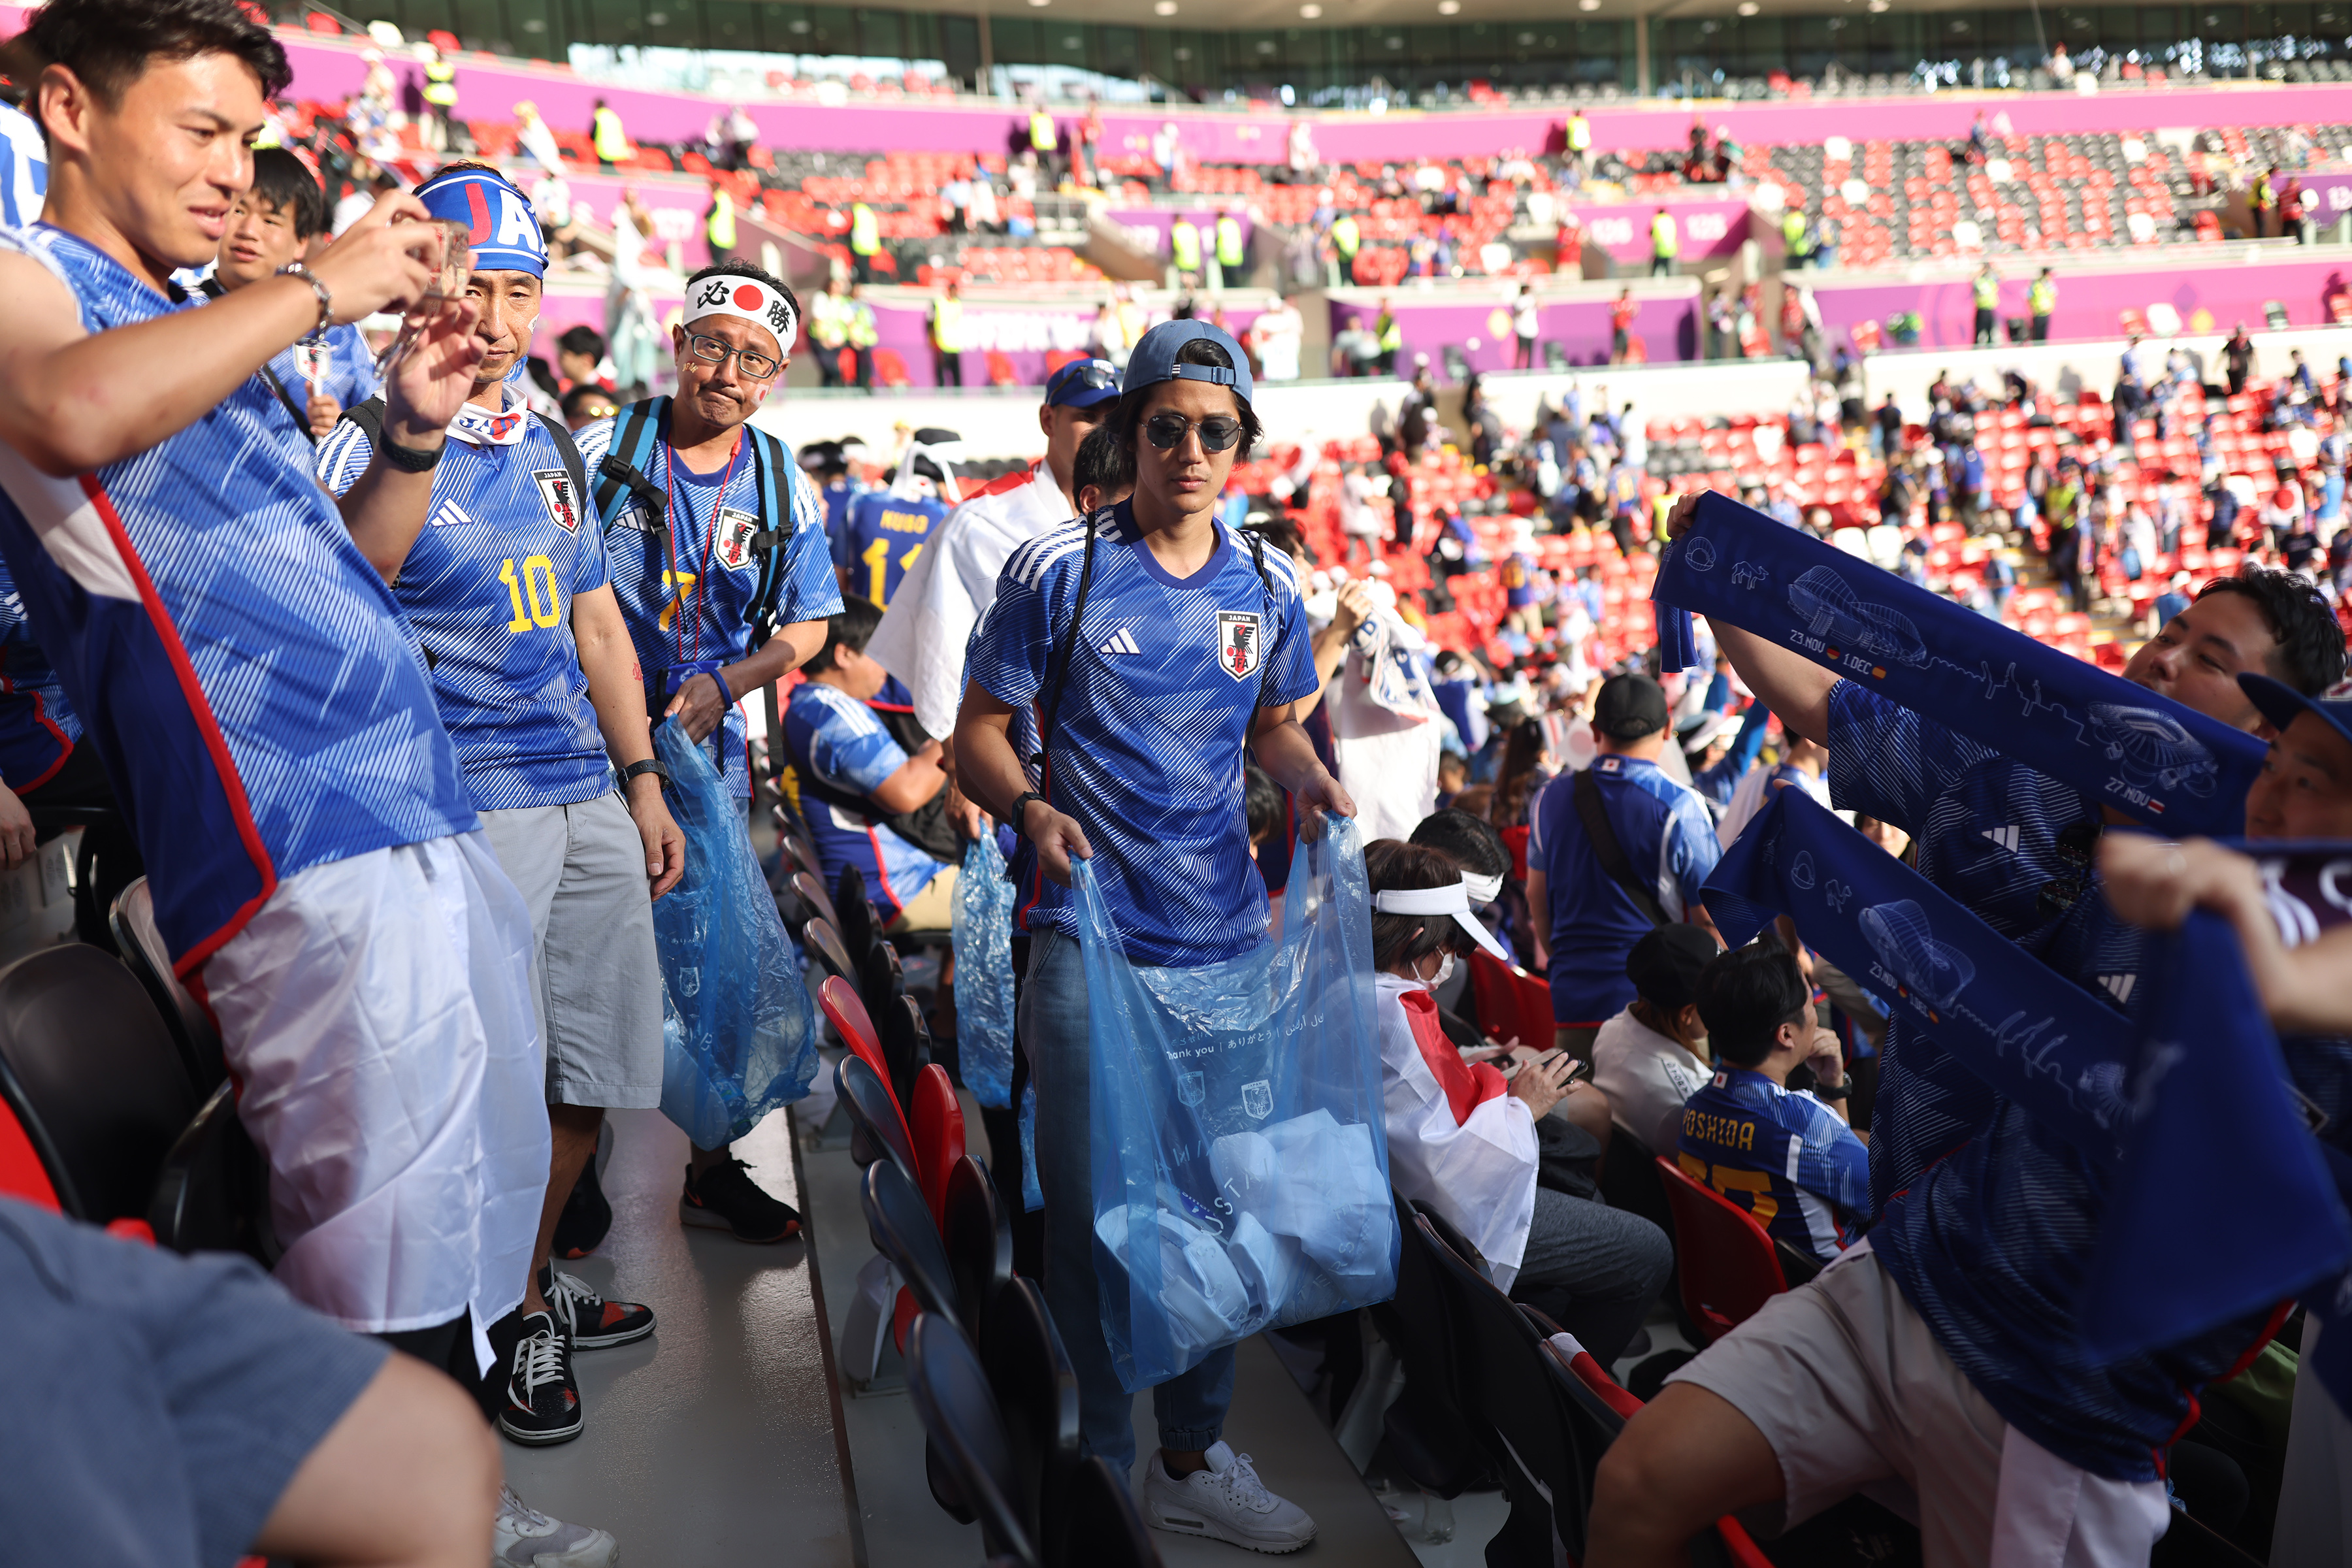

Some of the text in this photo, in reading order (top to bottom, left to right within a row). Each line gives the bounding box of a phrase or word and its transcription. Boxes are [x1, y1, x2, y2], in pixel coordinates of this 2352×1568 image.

[465, 182, 548, 253] JA
[562, 512, 576, 524] JFA
[731, 512, 753, 523] JAPAN
[725, 549, 742, 562] JFA
[498, 555, 561, 634] 10
[1789, 629, 1872, 675] 23.NOV 1.DEC
[1230, 657, 1249, 669] JFA
[2104, 776, 2151, 806] 27.NOV
[1227, 1030, 1273, 1049] ありがとう
[1166, 1045, 1215, 1060] Thank you
[1681, 1107, 1756, 1152] YOSHIDA
